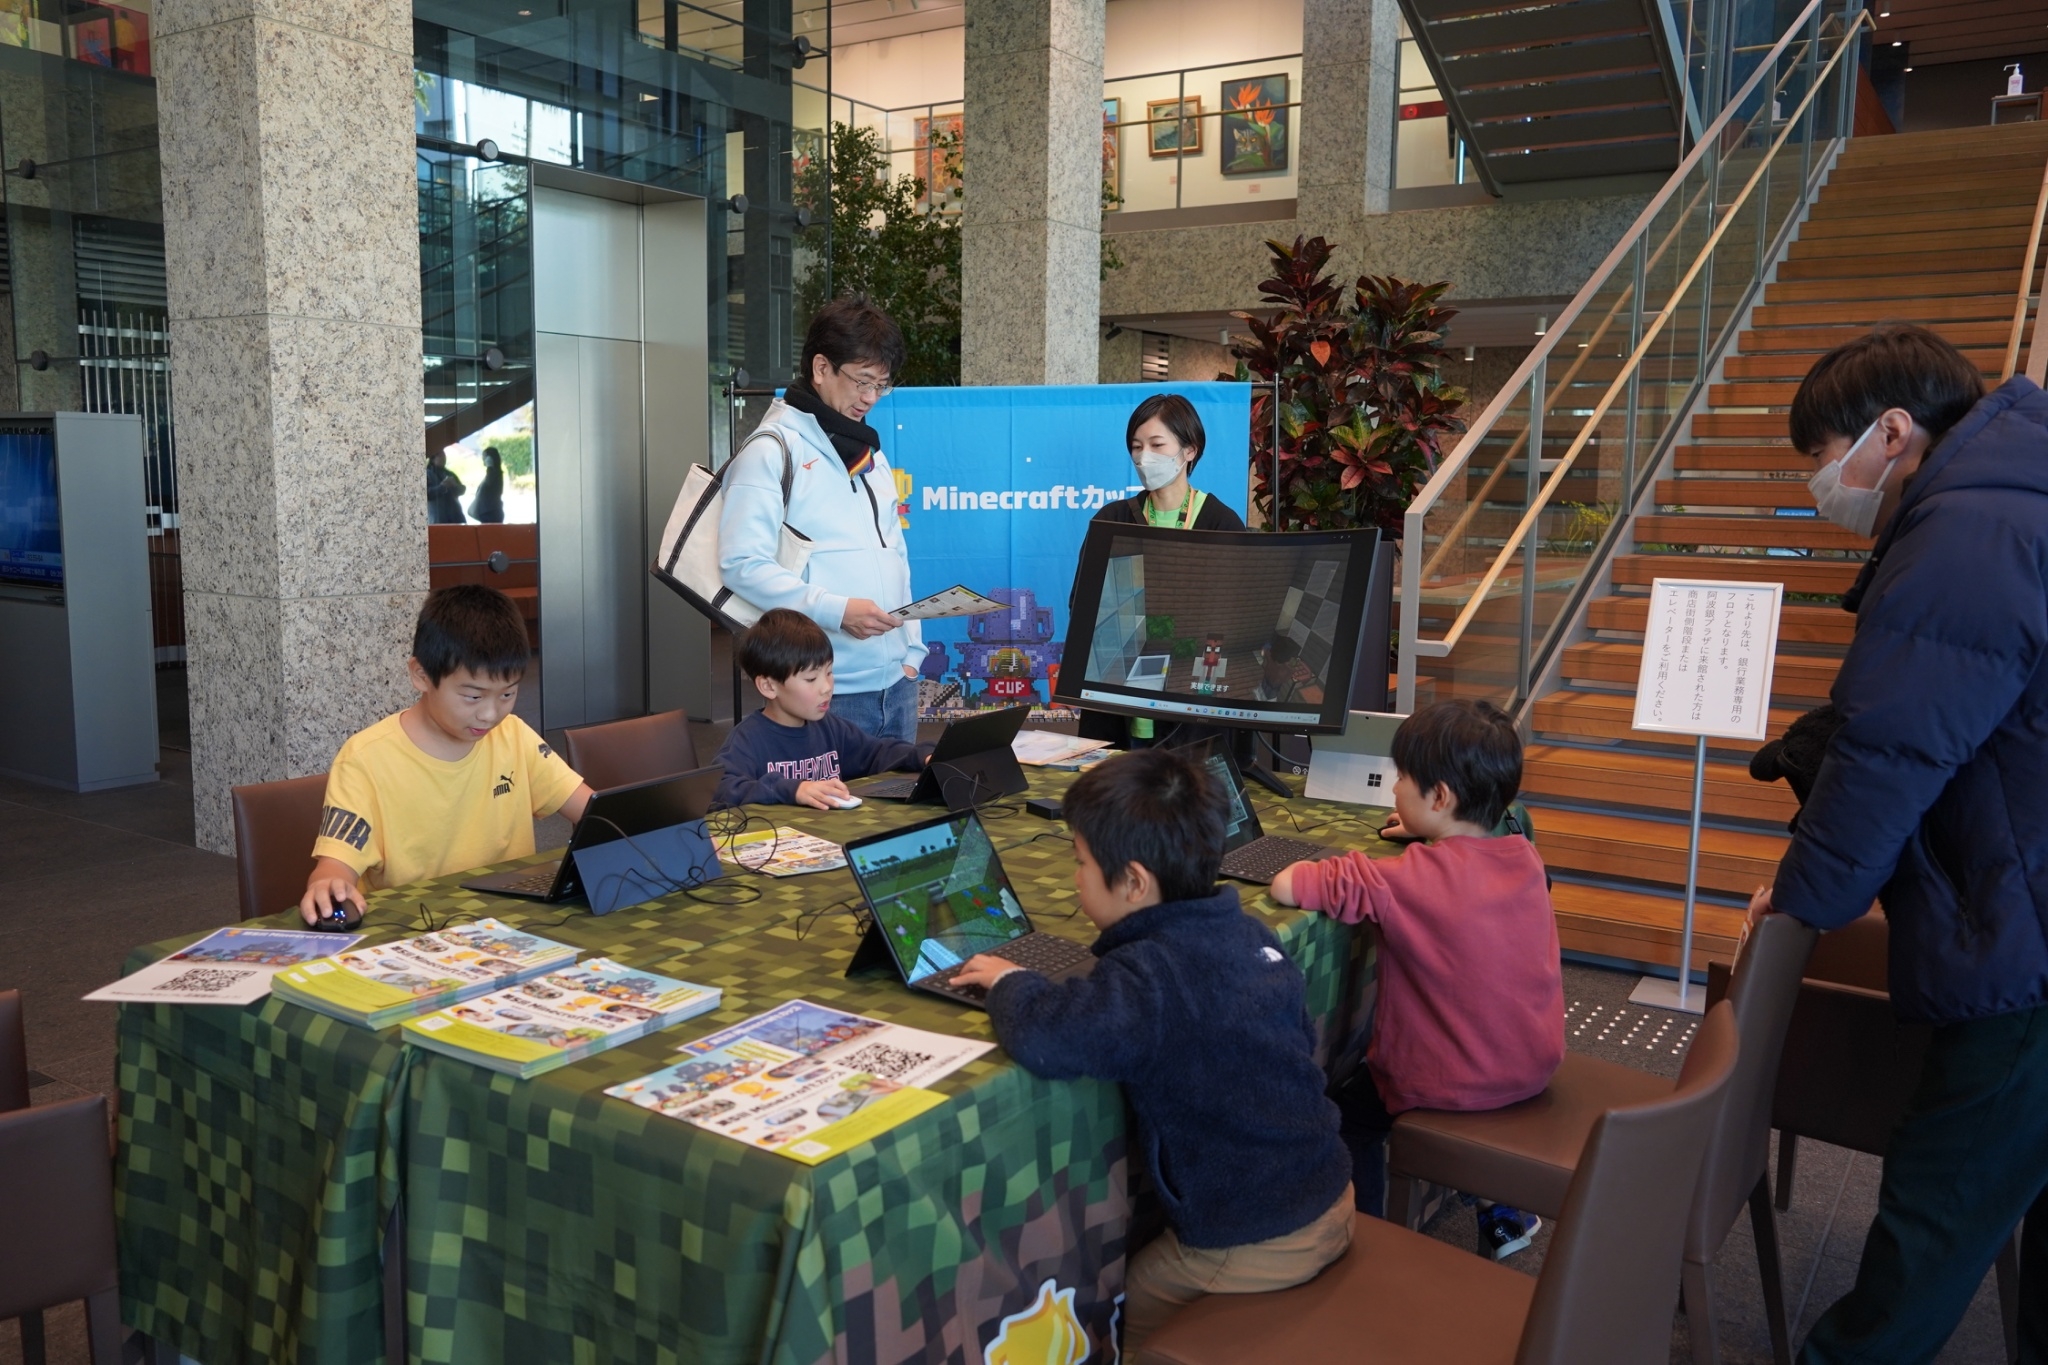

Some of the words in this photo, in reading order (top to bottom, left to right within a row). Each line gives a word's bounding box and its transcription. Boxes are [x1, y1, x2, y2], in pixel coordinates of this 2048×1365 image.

[1653, 590, 1678, 722] エレベーターをご利用ください。
[1678, 590, 1698, 672] 商店街側階段または
[1691, 591, 1718, 720] 阿波銀プラザに来館された方は
[1719, 592, 1736, 670] フロアとなります。
[994, 682, 1025, 694] CUP
[1190, 682, 1230, 693] 実験できます
